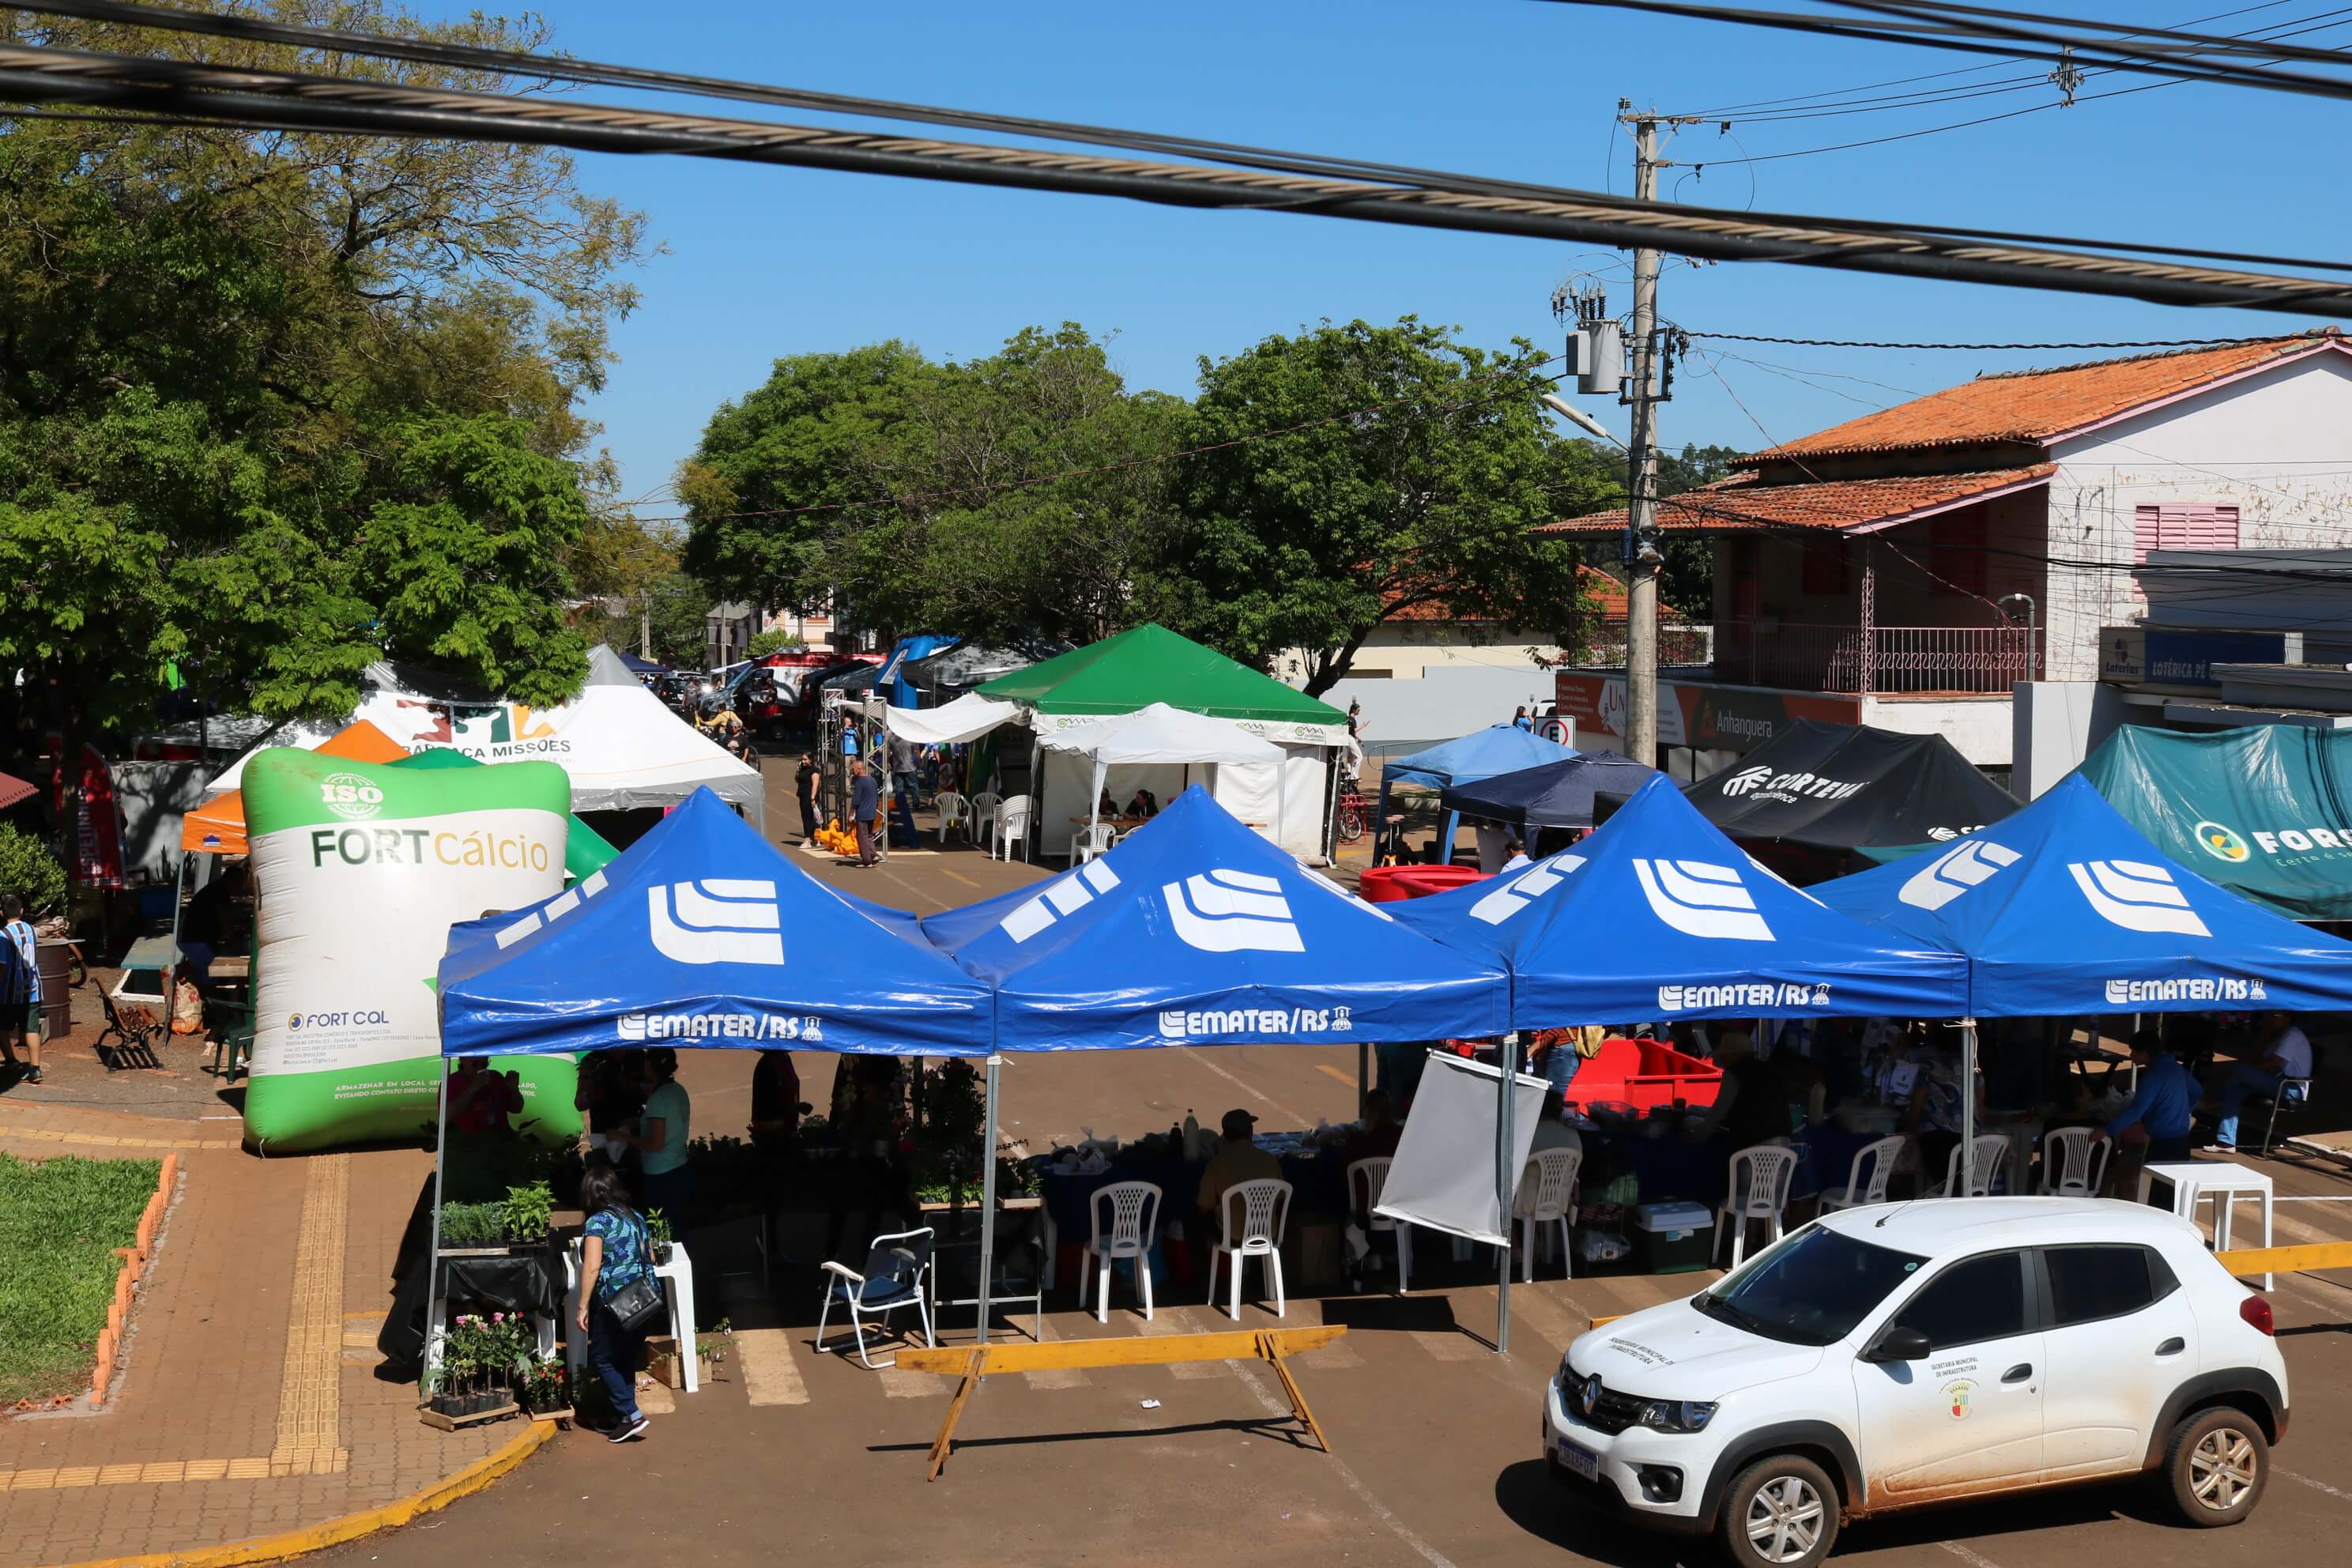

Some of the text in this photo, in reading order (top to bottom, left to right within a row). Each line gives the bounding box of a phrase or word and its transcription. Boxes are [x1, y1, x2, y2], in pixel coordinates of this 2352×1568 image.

[2152, 658, 2193, 679] LOTÉRICA
[2194, 659, 2207, 680] PÉ
[1716, 710, 1773, 742] Anhanguera
[492, 739, 571, 757] MISSÕES
[320, 783, 384, 804] ISO
[1766, 772, 1867, 800] CORTEVA
[2275, 854, 2320, 868] Certo
[307, 1012, 349, 1028] FORT
[334, 1090, 369, 1100] EVITANDO
[371, 1087, 402, 1096] CONTATO
[335, 1081, 384, 1091] ARMAZENAR
[1931, 1356, 1979, 1371] SECRETARIA MUNICIPAL
[1942, 1366, 1977, 1378] INFRAESTRUTURA
